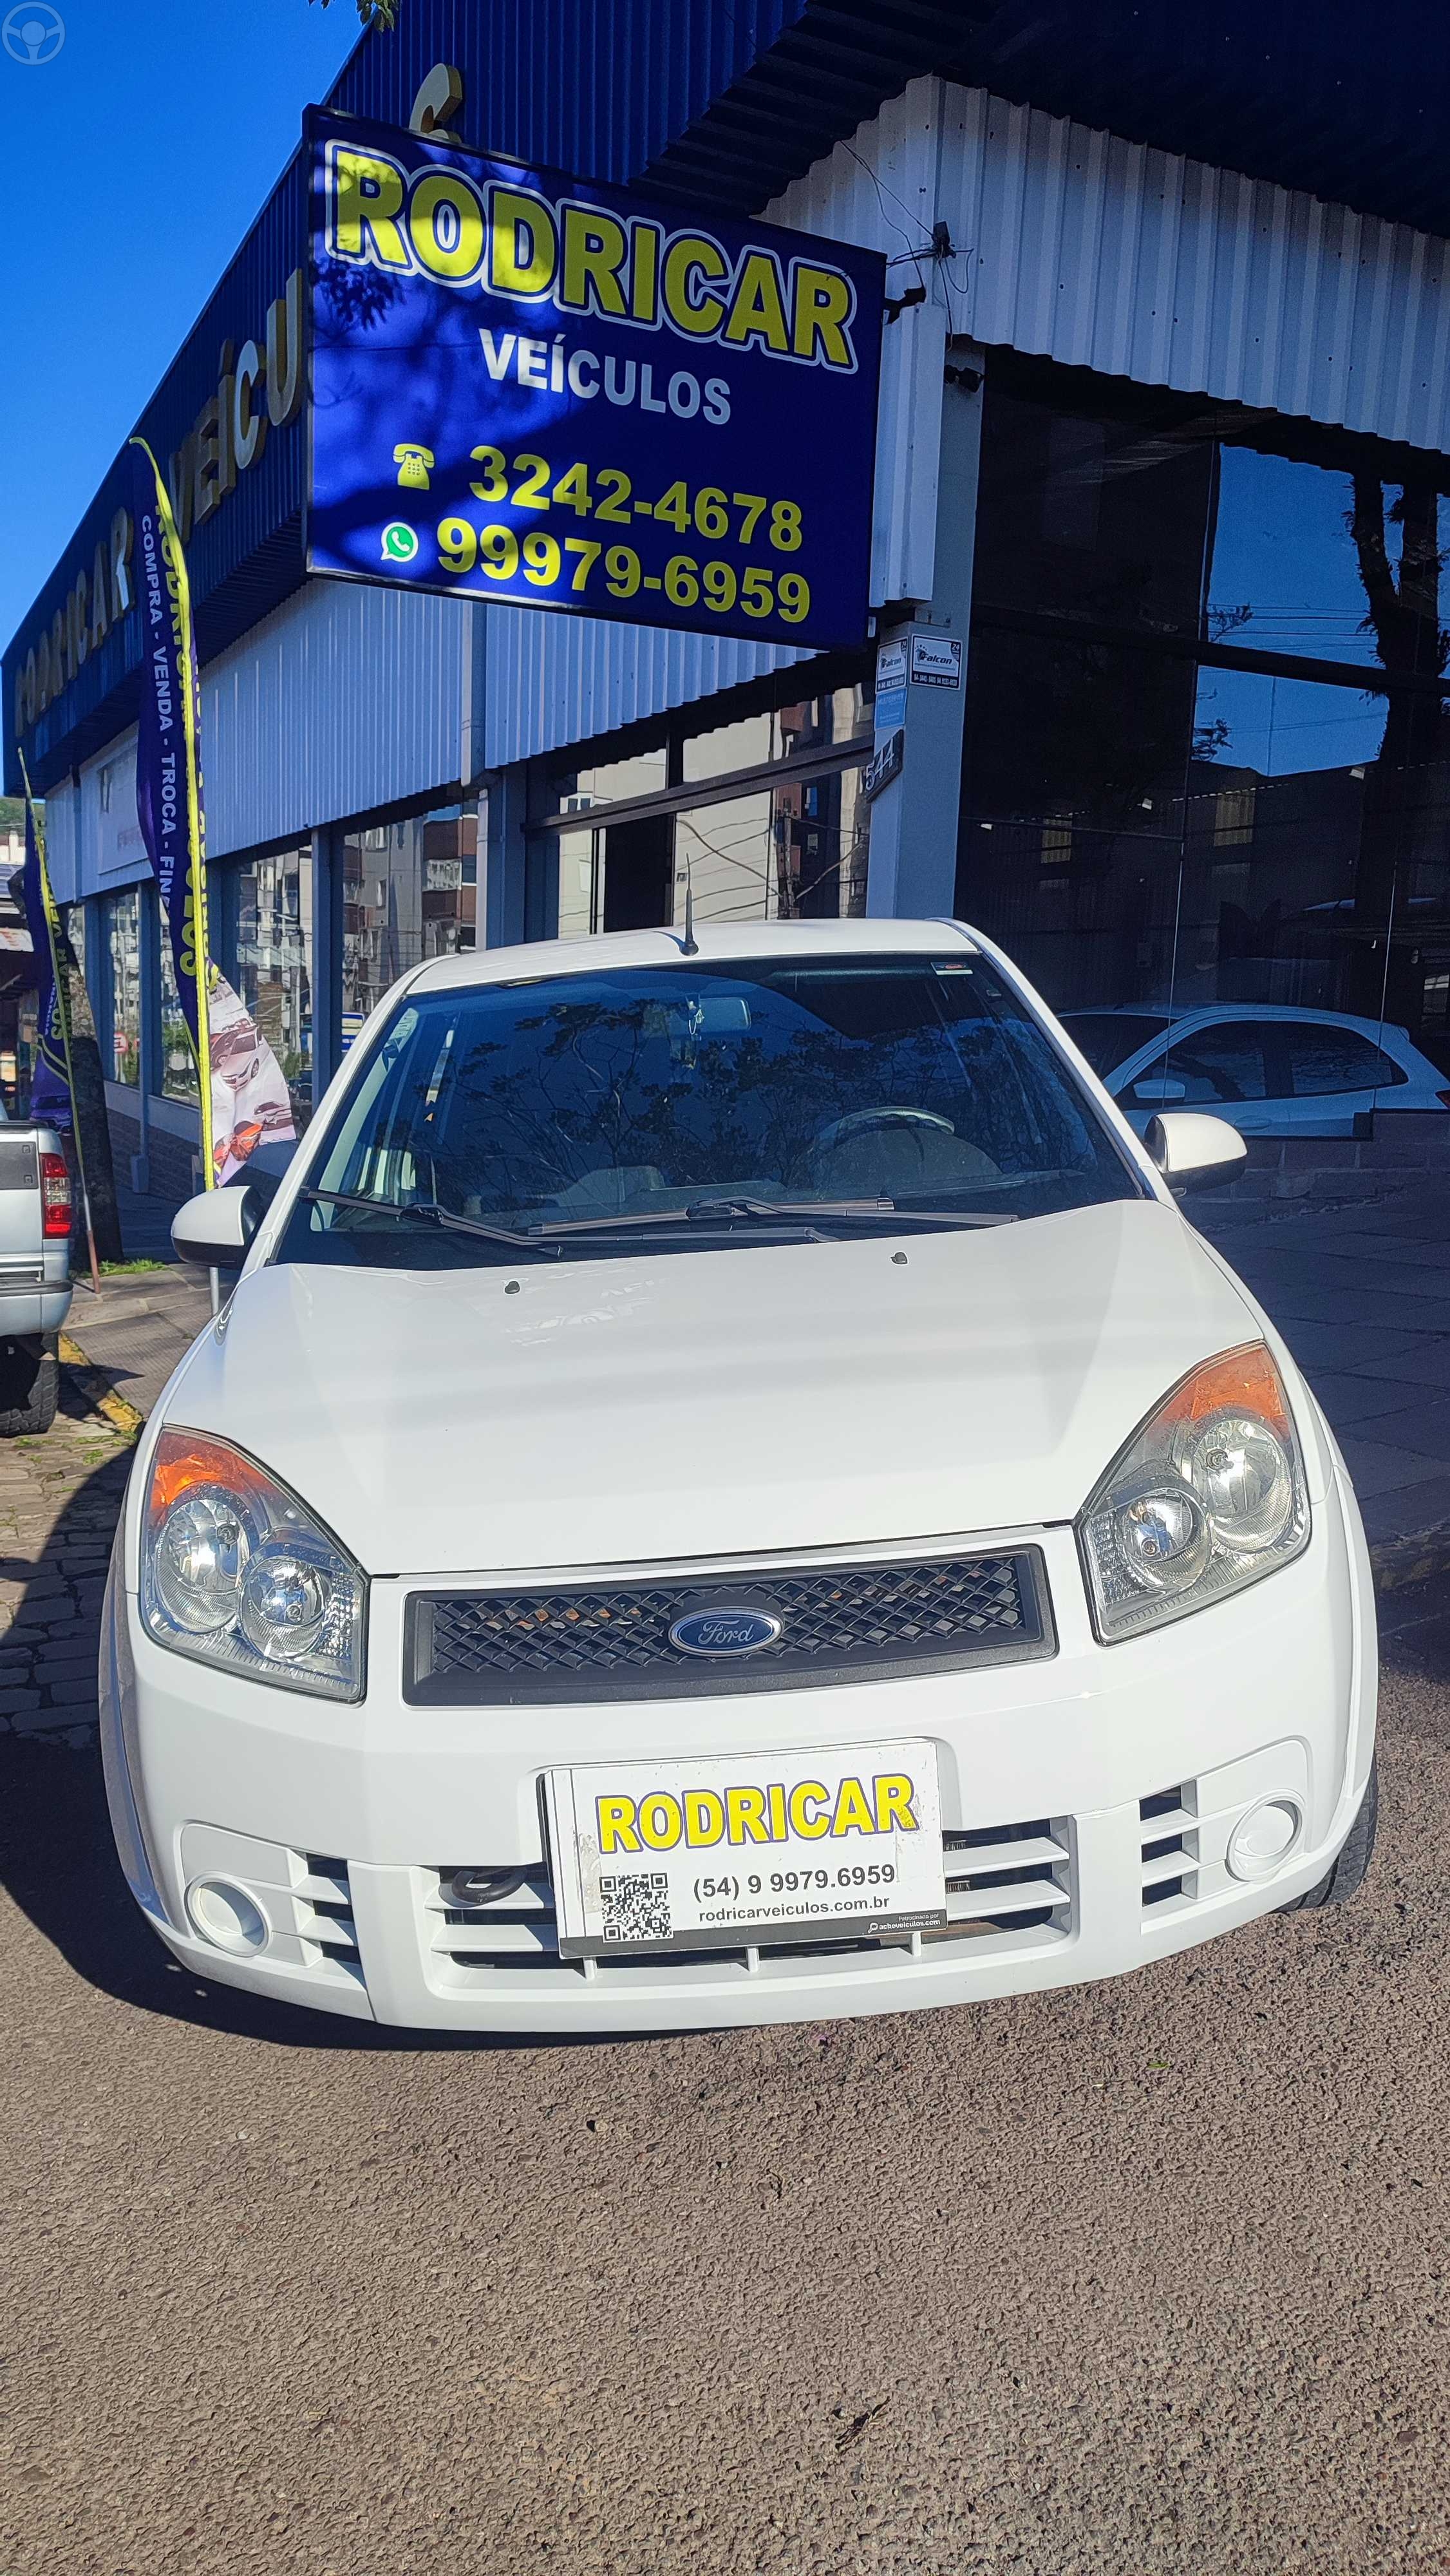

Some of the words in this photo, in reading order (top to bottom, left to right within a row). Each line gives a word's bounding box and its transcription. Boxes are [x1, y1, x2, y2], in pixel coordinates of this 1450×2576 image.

[326, 139, 859, 374] RODRICAR
[478, 328, 731, 425] VEÍCULOS
[469, 444, 804, 552] 3242-4678
[142, 515, 163, 625] COMPRA
[437, 517, 811, 623] 99979-6959
[153, 645, 173, 732] VENDA
[161, 752, 177, 835] TROCA
[865, 738, 895, 791] 544
[698, 1620, 753, 1644] Ford
[596, 1773, 919, 1855] RODRICAR
[693, 1875, 740, 1904] (54)
[748, 1875, 762, 1894] 9
[770, 1864, 896, 1893] 9979.6959
[699, 1895, 890, 1922] rodricarveiculos.com.br
